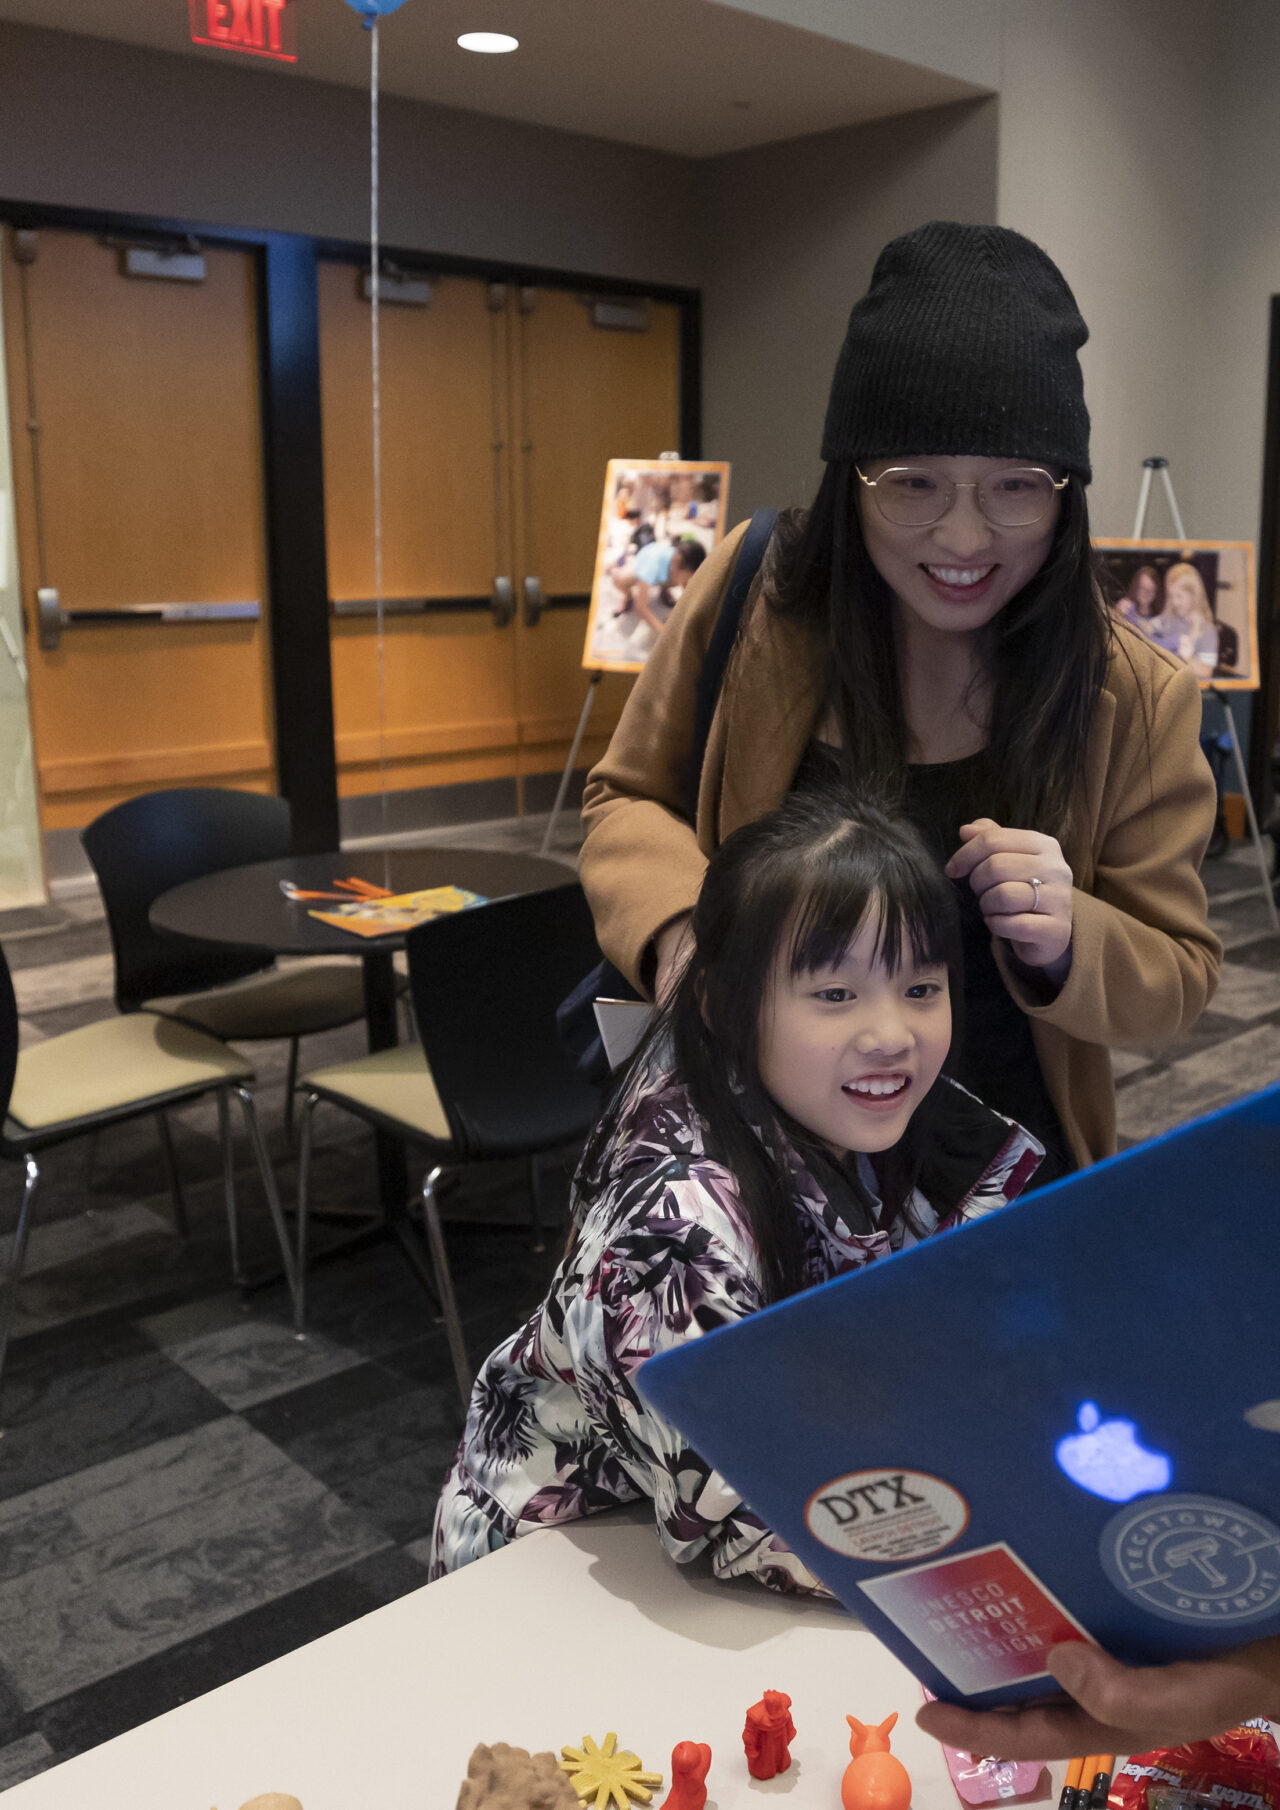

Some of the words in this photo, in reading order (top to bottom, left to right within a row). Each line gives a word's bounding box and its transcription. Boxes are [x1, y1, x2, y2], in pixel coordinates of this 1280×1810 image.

[206, 0, 285, 51] EXIT
[817, 1475, 924, 1525] DTX
[1127, 1511, 1248, 1570] TECHTOWN
[917, 1582, 1004, 1617] UNESCO
[1176, 1570, 1277, 1613] DETROIT
[927, 1597, 1025, 1633] DETROIT
[1000, 1616, 1028, 1635] OF
[957, 1633, 1043, 1663] DESIGN
